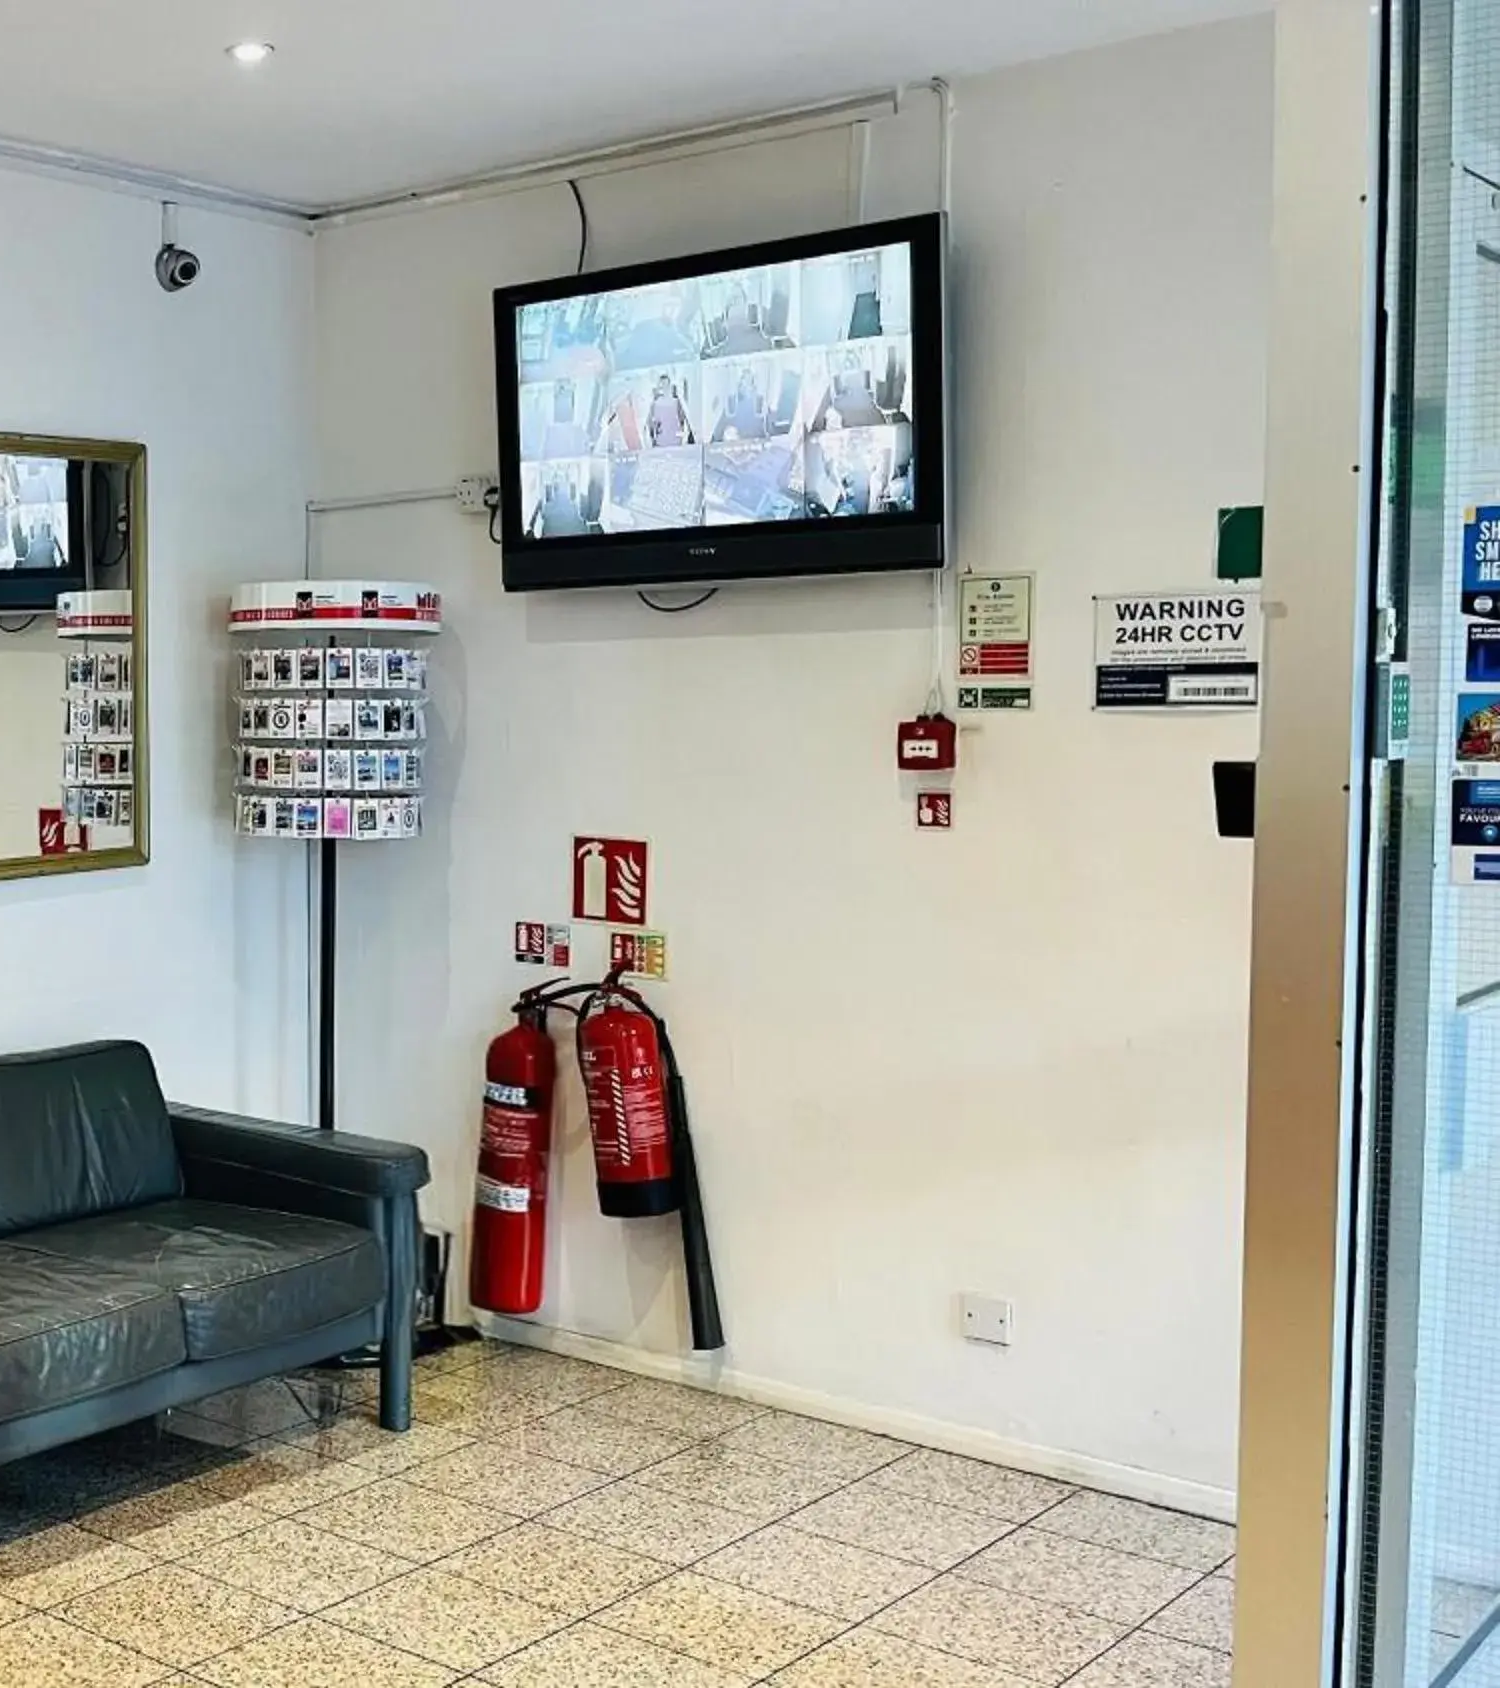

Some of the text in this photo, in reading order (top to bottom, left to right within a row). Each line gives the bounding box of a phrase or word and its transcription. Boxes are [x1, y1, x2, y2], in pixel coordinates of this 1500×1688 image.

[1475, 541, 1499, 561] SM
[1116, 598, 1245, 621] WARNING
[1116, 623, 1244, 644] 24HR CCTV
